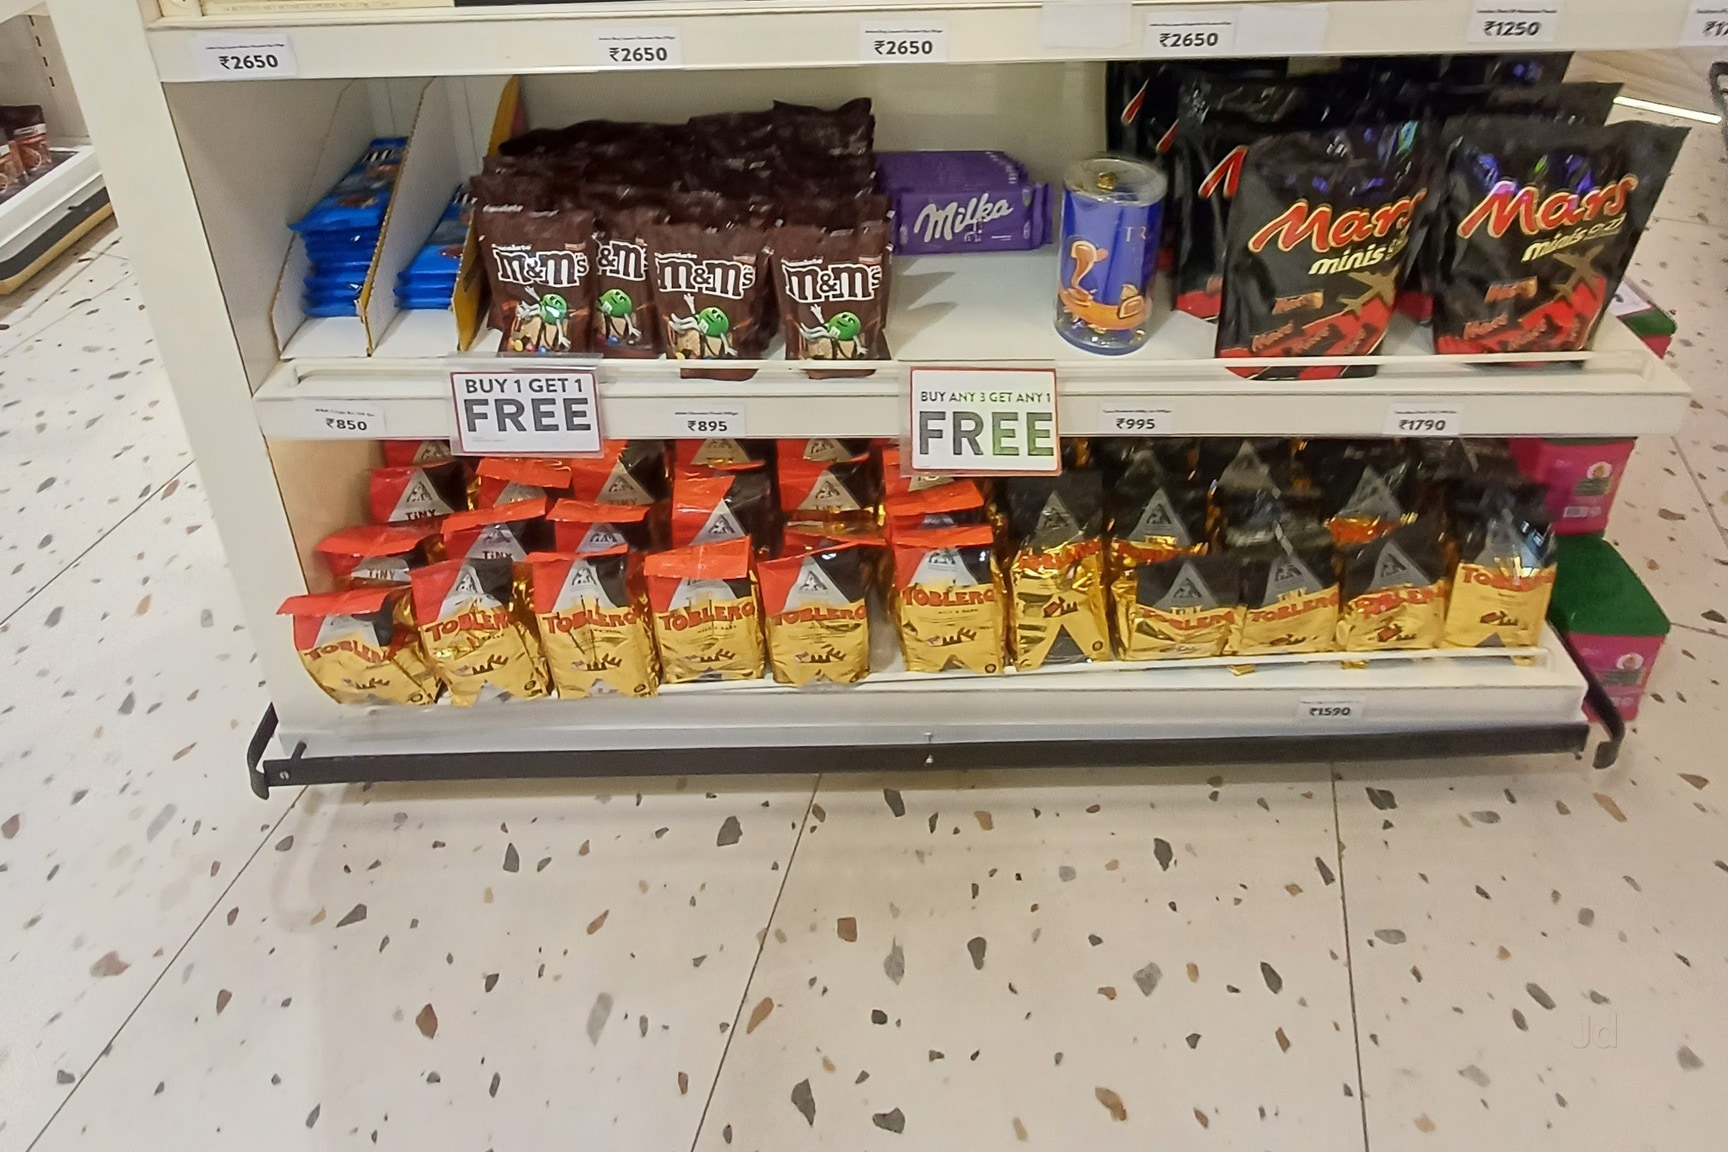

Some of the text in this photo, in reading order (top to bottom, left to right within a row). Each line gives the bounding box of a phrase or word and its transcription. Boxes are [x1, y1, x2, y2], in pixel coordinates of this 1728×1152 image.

[1484, 20, 1542, 36] ₹1250
[874, 40, 934, 56] ₹2650
[1159, 32, 1219, 48] ₹2650
[218, 54, 279, 70] ₹2650
[609, 47, 668, 62] ₹2650
[1457, 173, 1639, 239] Mars
[914, 193, 1014, 243] Milka
[1521, 226, 1586, 263] minis
[1308, 244, 1386, 275] minis
[465, 378, 583, 394] BUY 1 GET 1
[921, 391, 1051, 403] BUY ANY 3 GET ANY 1
[464, 398, 591, 432] FREE
[326, 417, 367, 431] ₹850
[687, 420, 728, 432] ₹895
[1116, 418, 1155, 429] ₹995
[1399, 419, 1446, 431] ₹1790
[919, 411, 1054, 456] FREE
